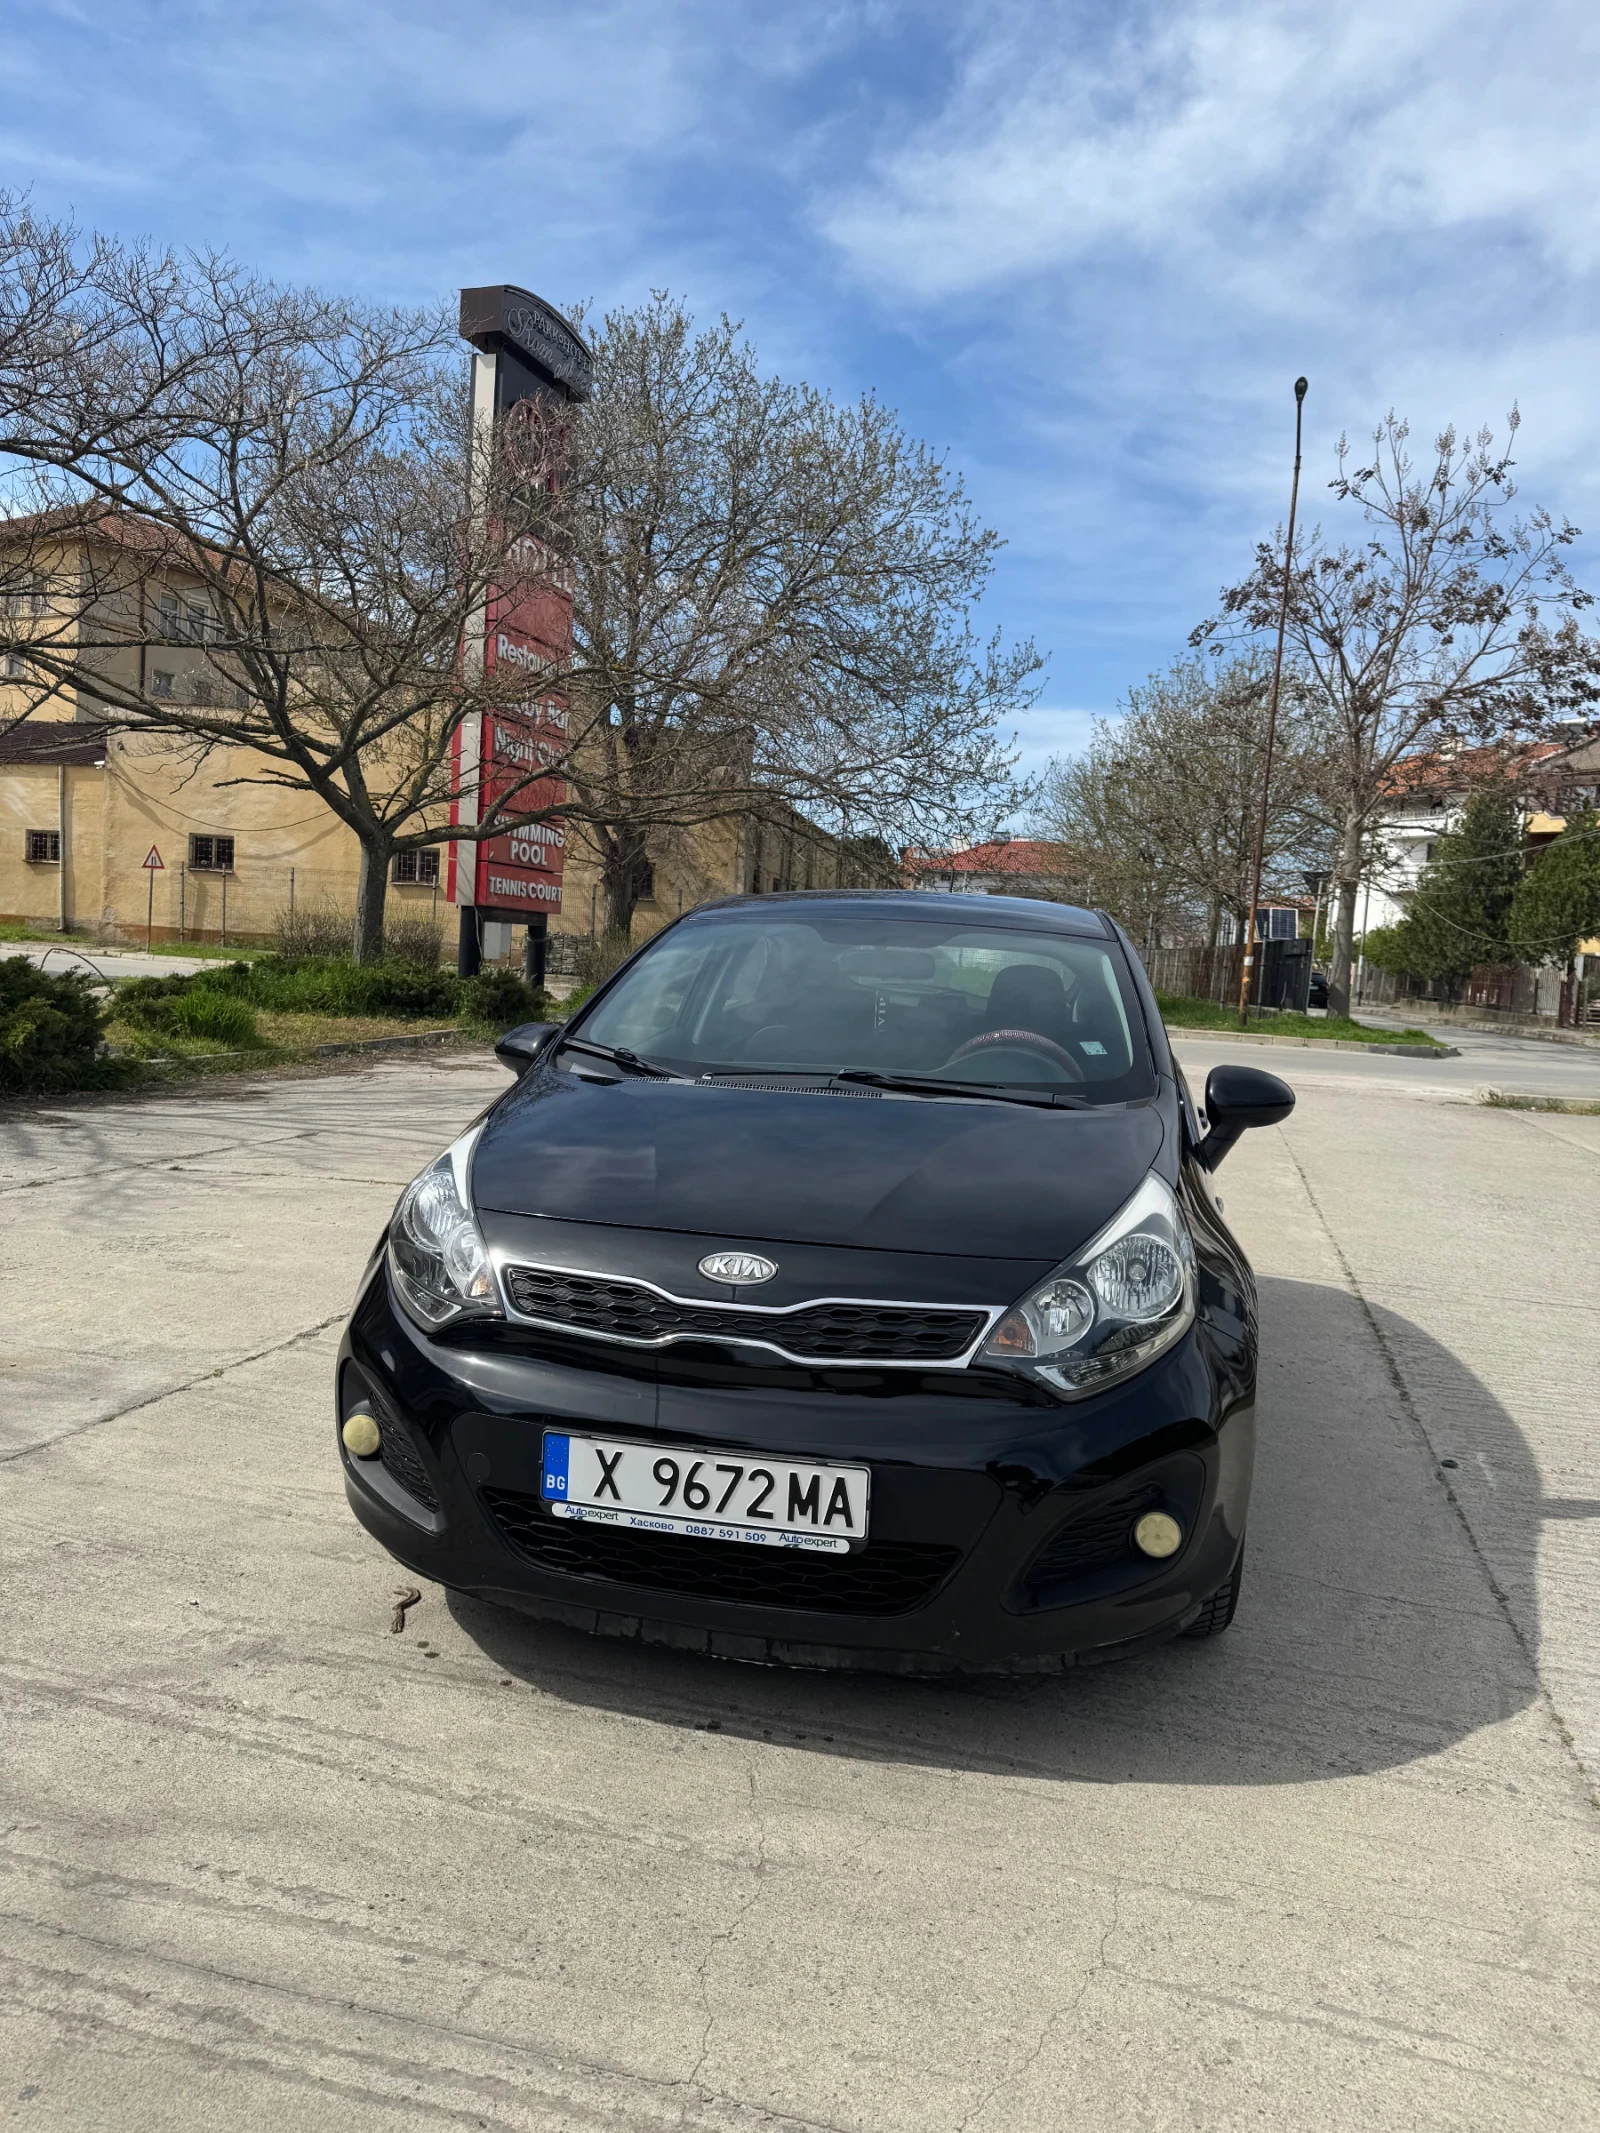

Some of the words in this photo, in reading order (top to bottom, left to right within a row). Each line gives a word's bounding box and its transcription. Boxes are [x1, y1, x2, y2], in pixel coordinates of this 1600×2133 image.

[510, 840, 548, 866] POOL
[489, 876, 527, 897] TENNIS
[528, 882, 563, 902] COURT
[711, 1256, 763, 1278] KIA
[546, 1474, 566, 1490] BG
[593, 1449, 623, 1500] X
[653, 1457, 775, 1520] 9672
[787, 1472, 854, 1528] MA
[629, 1516, 674, 1531] Хасково
[685, 1524, 715, 1537] 0887
[718, 1529, 740, 1540] 591
[744, 1532, 767, 1542] 509
